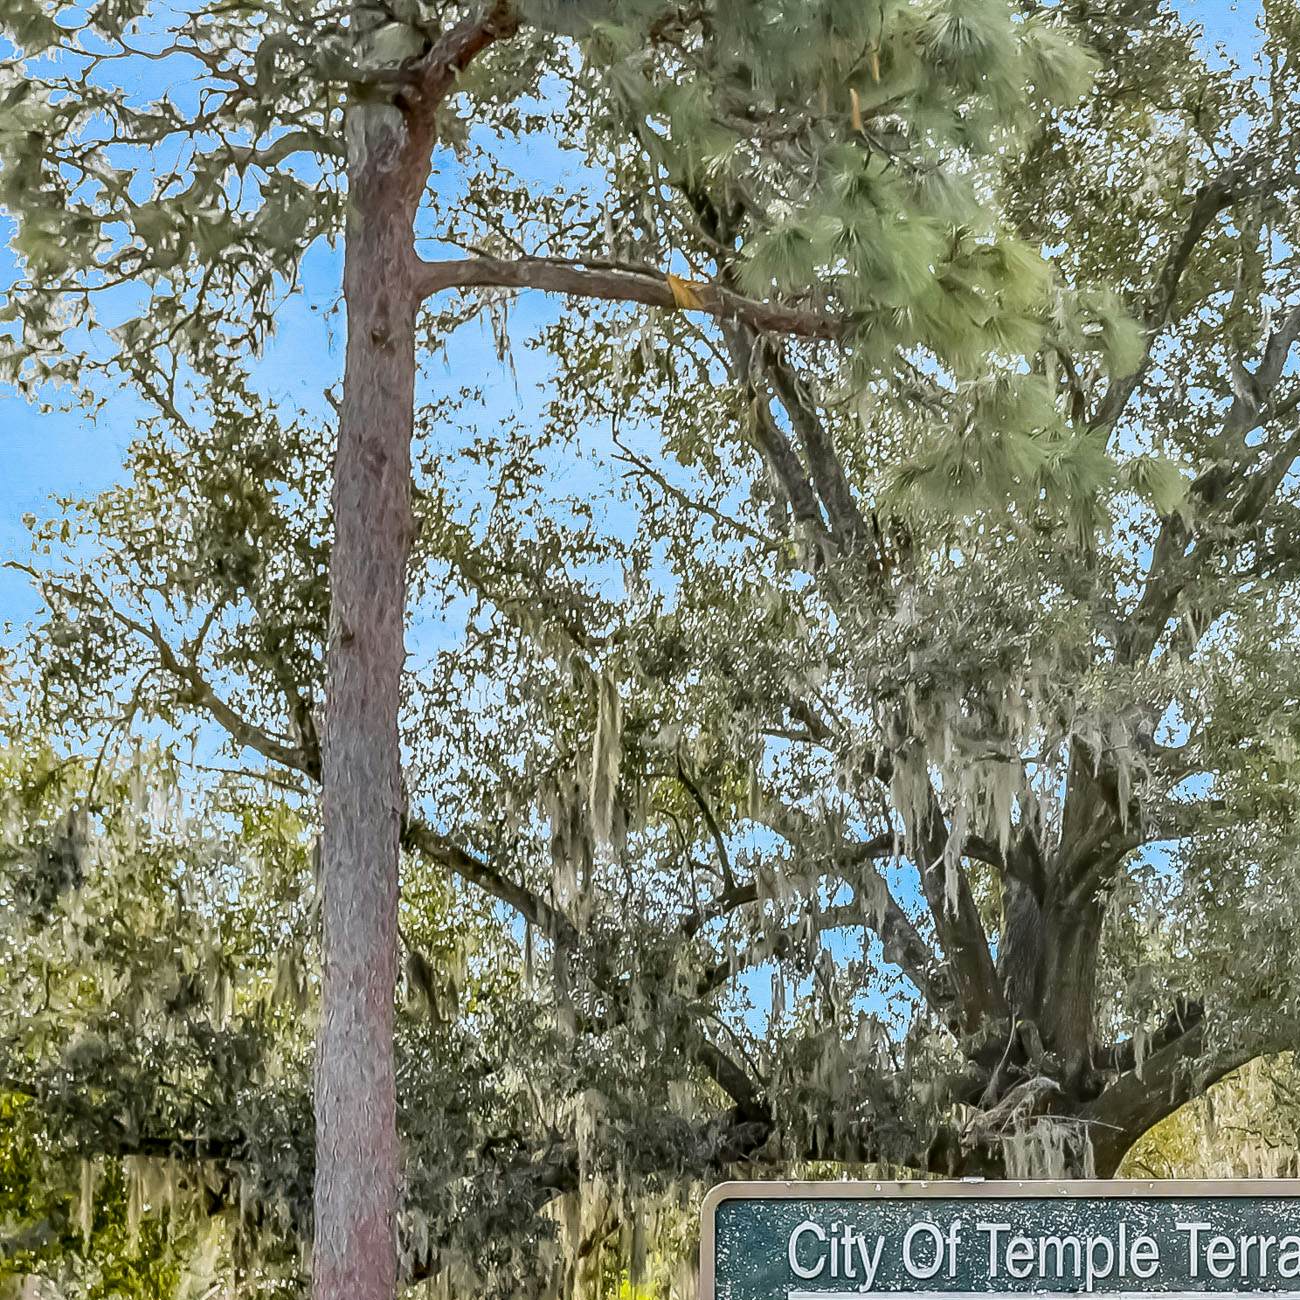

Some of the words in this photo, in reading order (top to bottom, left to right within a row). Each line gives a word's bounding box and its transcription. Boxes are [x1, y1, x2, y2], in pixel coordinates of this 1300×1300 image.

[788, 1222, 884, 1292] City
[902, 1222, 959, 1279] Of
[978, 1222, 1160, 1291] Temple
